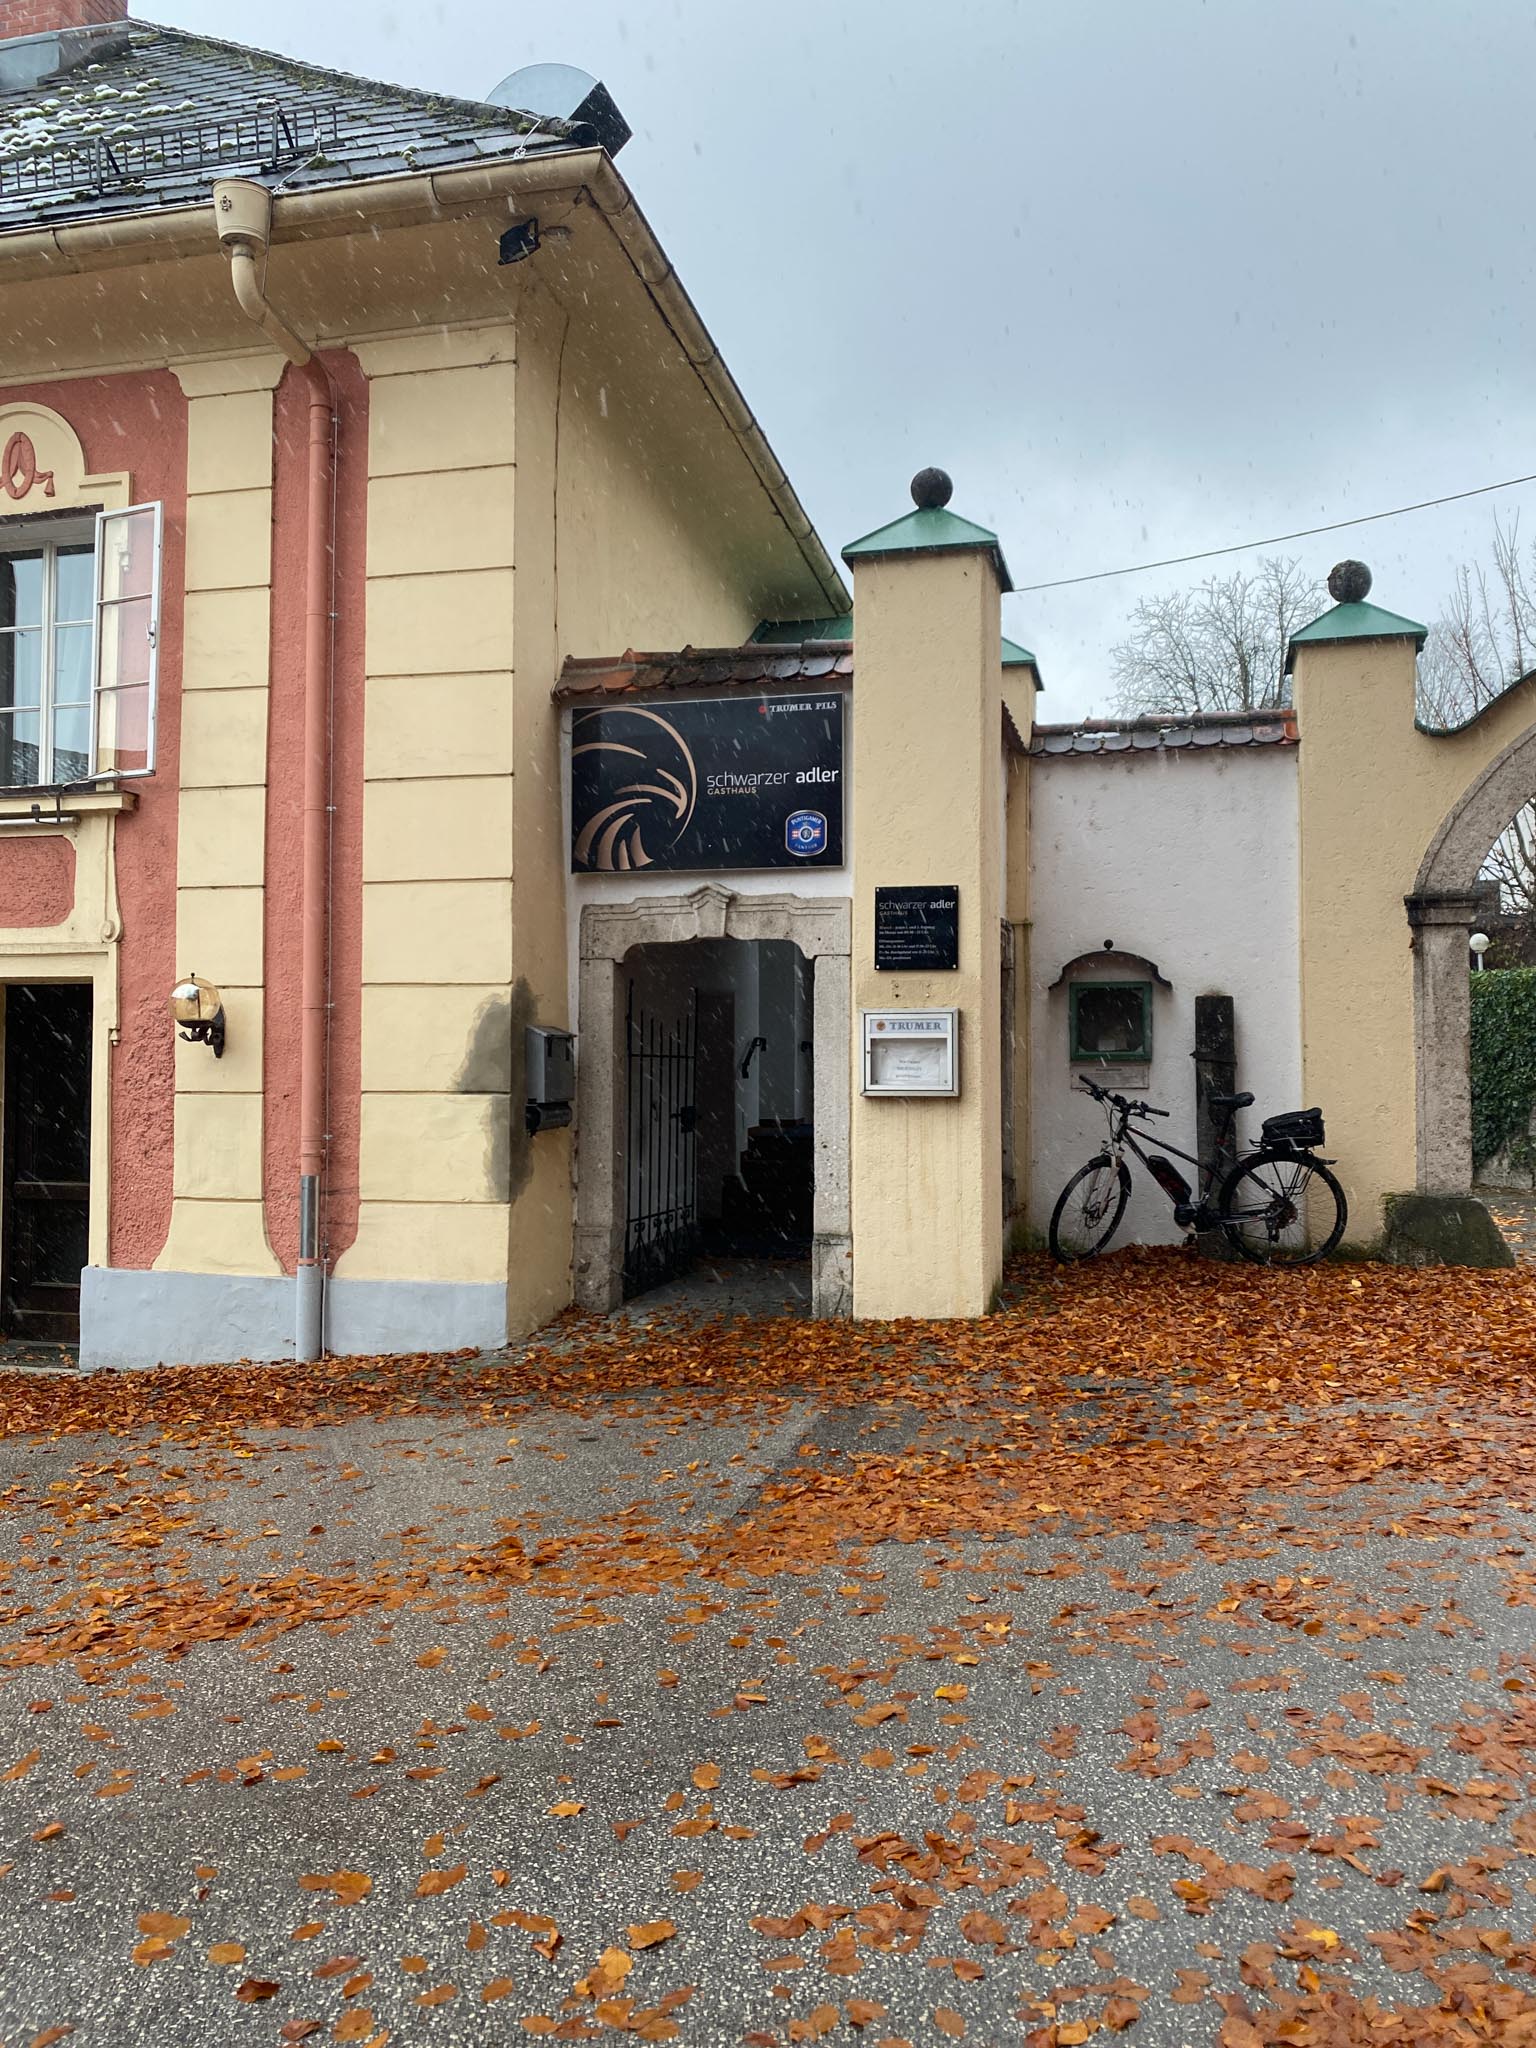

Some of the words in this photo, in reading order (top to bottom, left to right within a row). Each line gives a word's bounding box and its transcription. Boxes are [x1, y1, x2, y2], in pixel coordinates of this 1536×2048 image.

[769, 702, 813, 713] TRUMER
[816, 701, 838, 711] PILS
[706, 770, 790, 788] schwarzer
[795, 766, 839, 784] adler
[706, 786, 757, 796] GASTHAUS
[879, 899, 927, 910] schwarzer
[929, 899, 956, 909] adler
[889, 1021, 942, 1031] TRUMER
